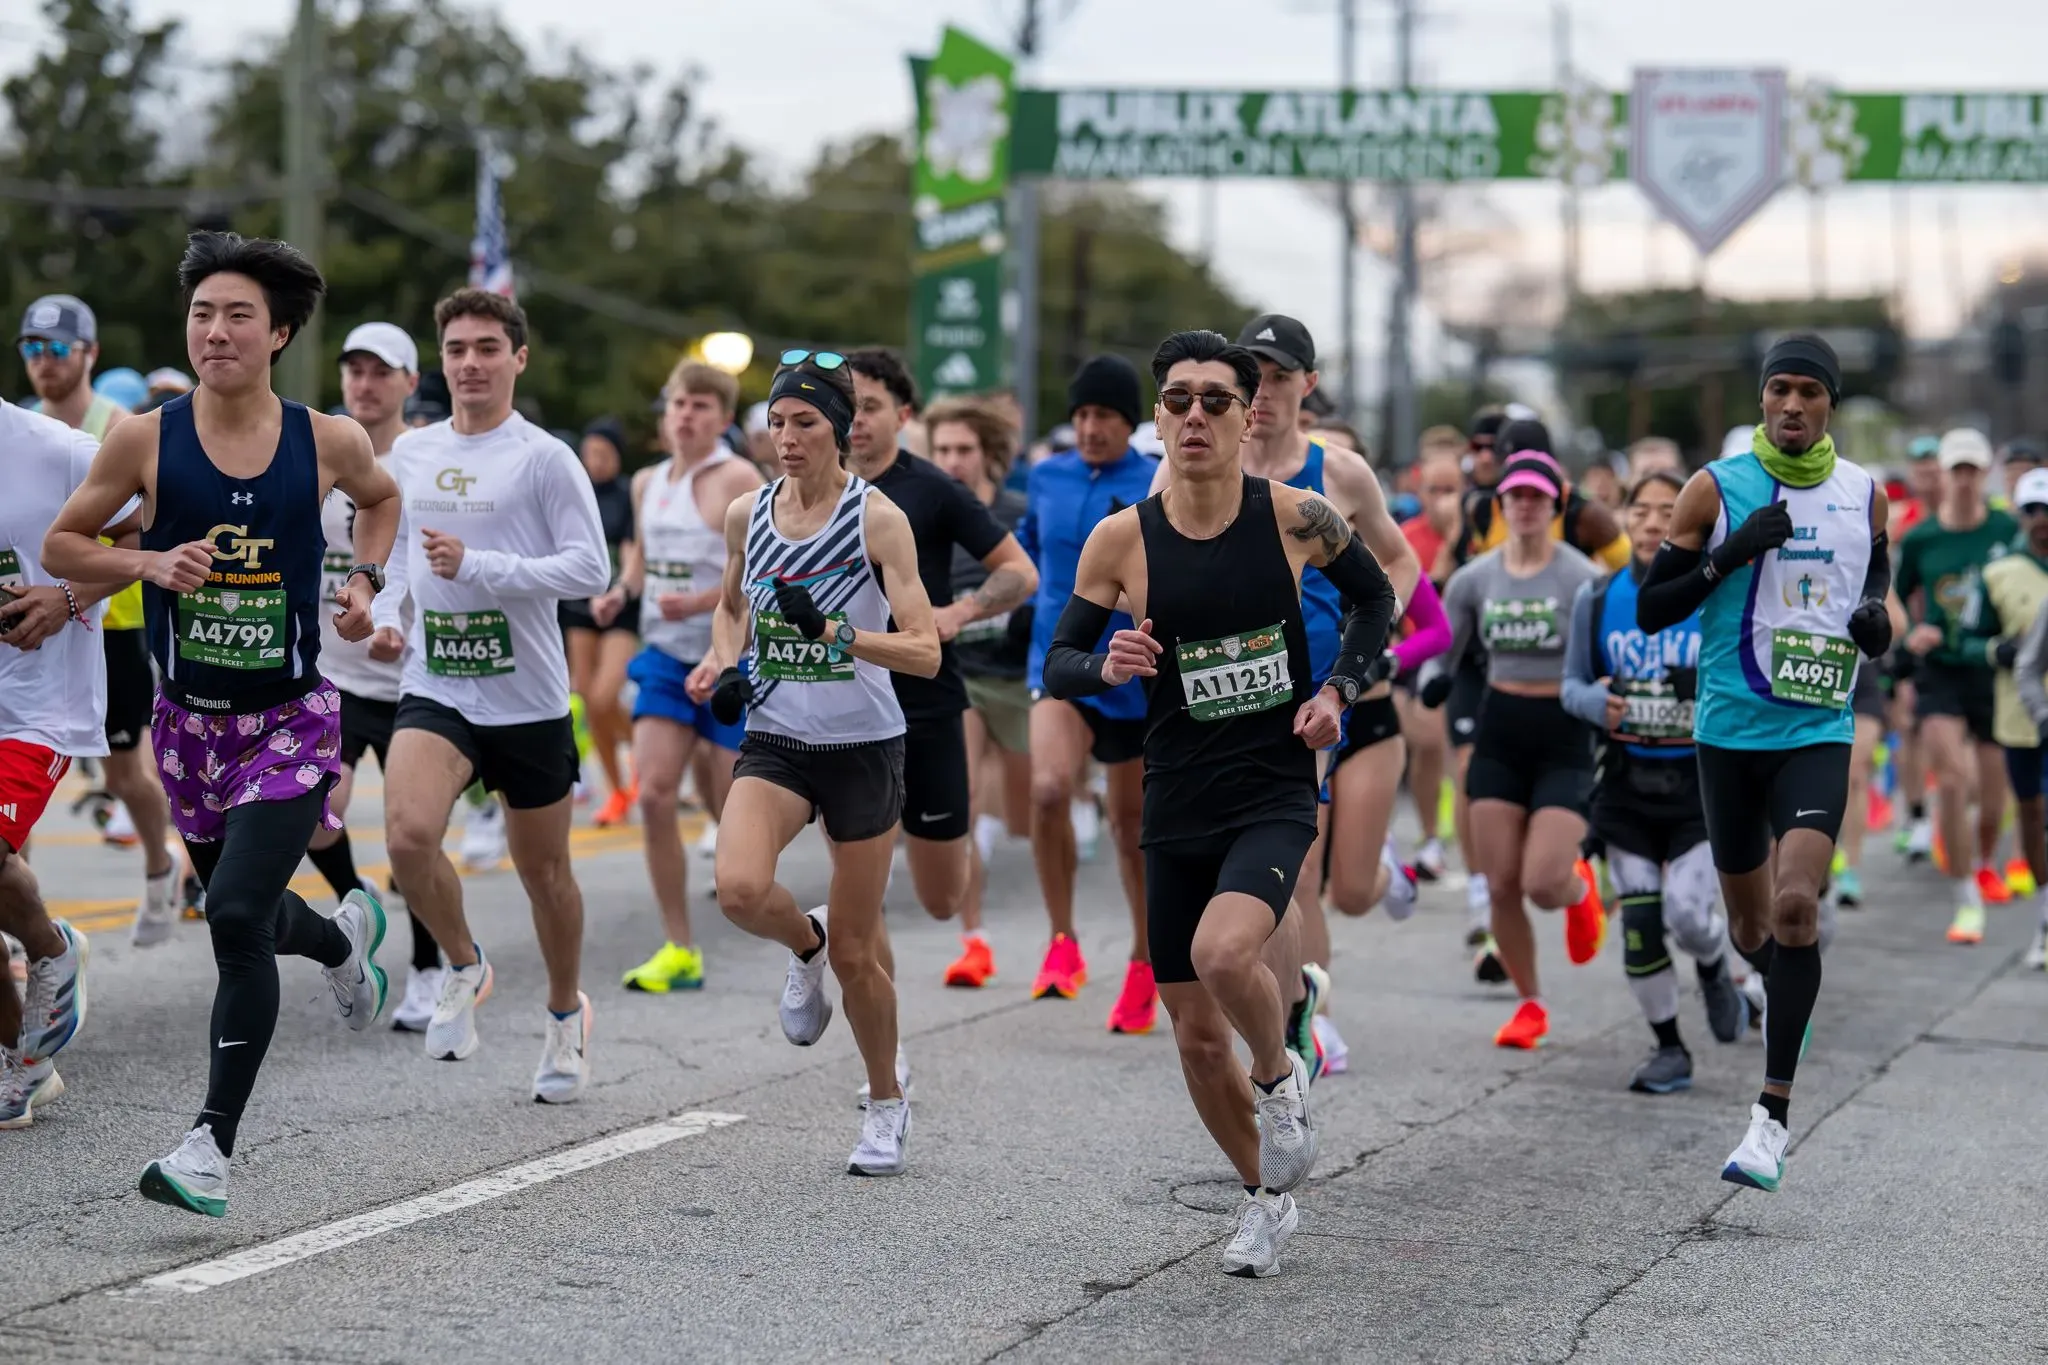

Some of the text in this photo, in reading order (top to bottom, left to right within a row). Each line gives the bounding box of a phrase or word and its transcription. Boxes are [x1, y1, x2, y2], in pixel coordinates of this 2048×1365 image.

[1056, 93, 1498, 138] PUBLIX ATLANTA
[1053, 140, 1500, 178] MARATHON WEEKEND
[435, 468, 477, 496] GT
[412, 500, 494, 513] GEORGIA TECH
[205, 524, 274, 569] GT
[225, 572, 281, 584] RUNNING
[189, 619, 274, 647] A4799
[204, 656, 219, 664] BEER
[222, 658, 244, 667] TICKET
[433, 638, 503, 660] A4465
[1192, 660, 1281, 701] A11251
[1777, 659, 1843, 690] A4951
[1219, 703, 1261, 716] BEER TICKET
